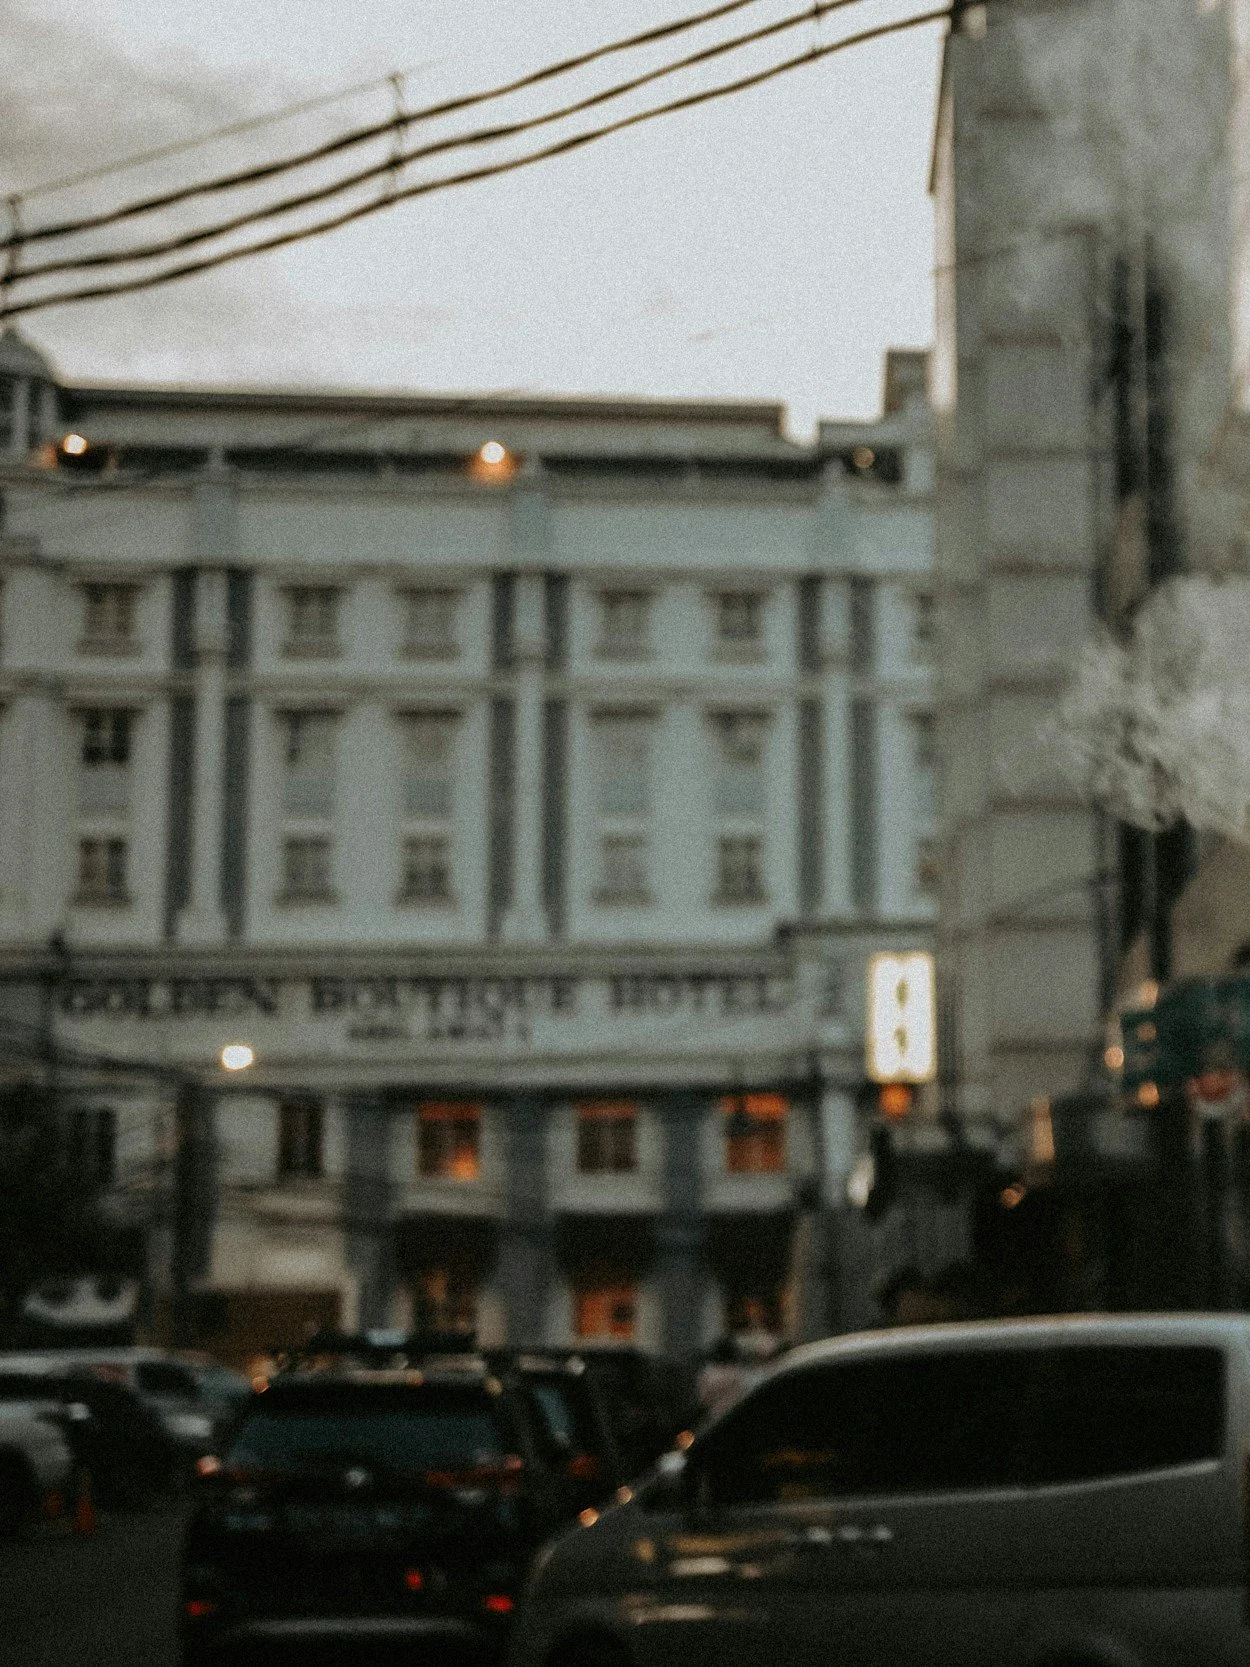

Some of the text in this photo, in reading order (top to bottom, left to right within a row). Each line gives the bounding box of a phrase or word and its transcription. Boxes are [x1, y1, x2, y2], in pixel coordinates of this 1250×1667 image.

[60, 975, 788, 1016] GOLDEN BOUTIQUE HOTEL
